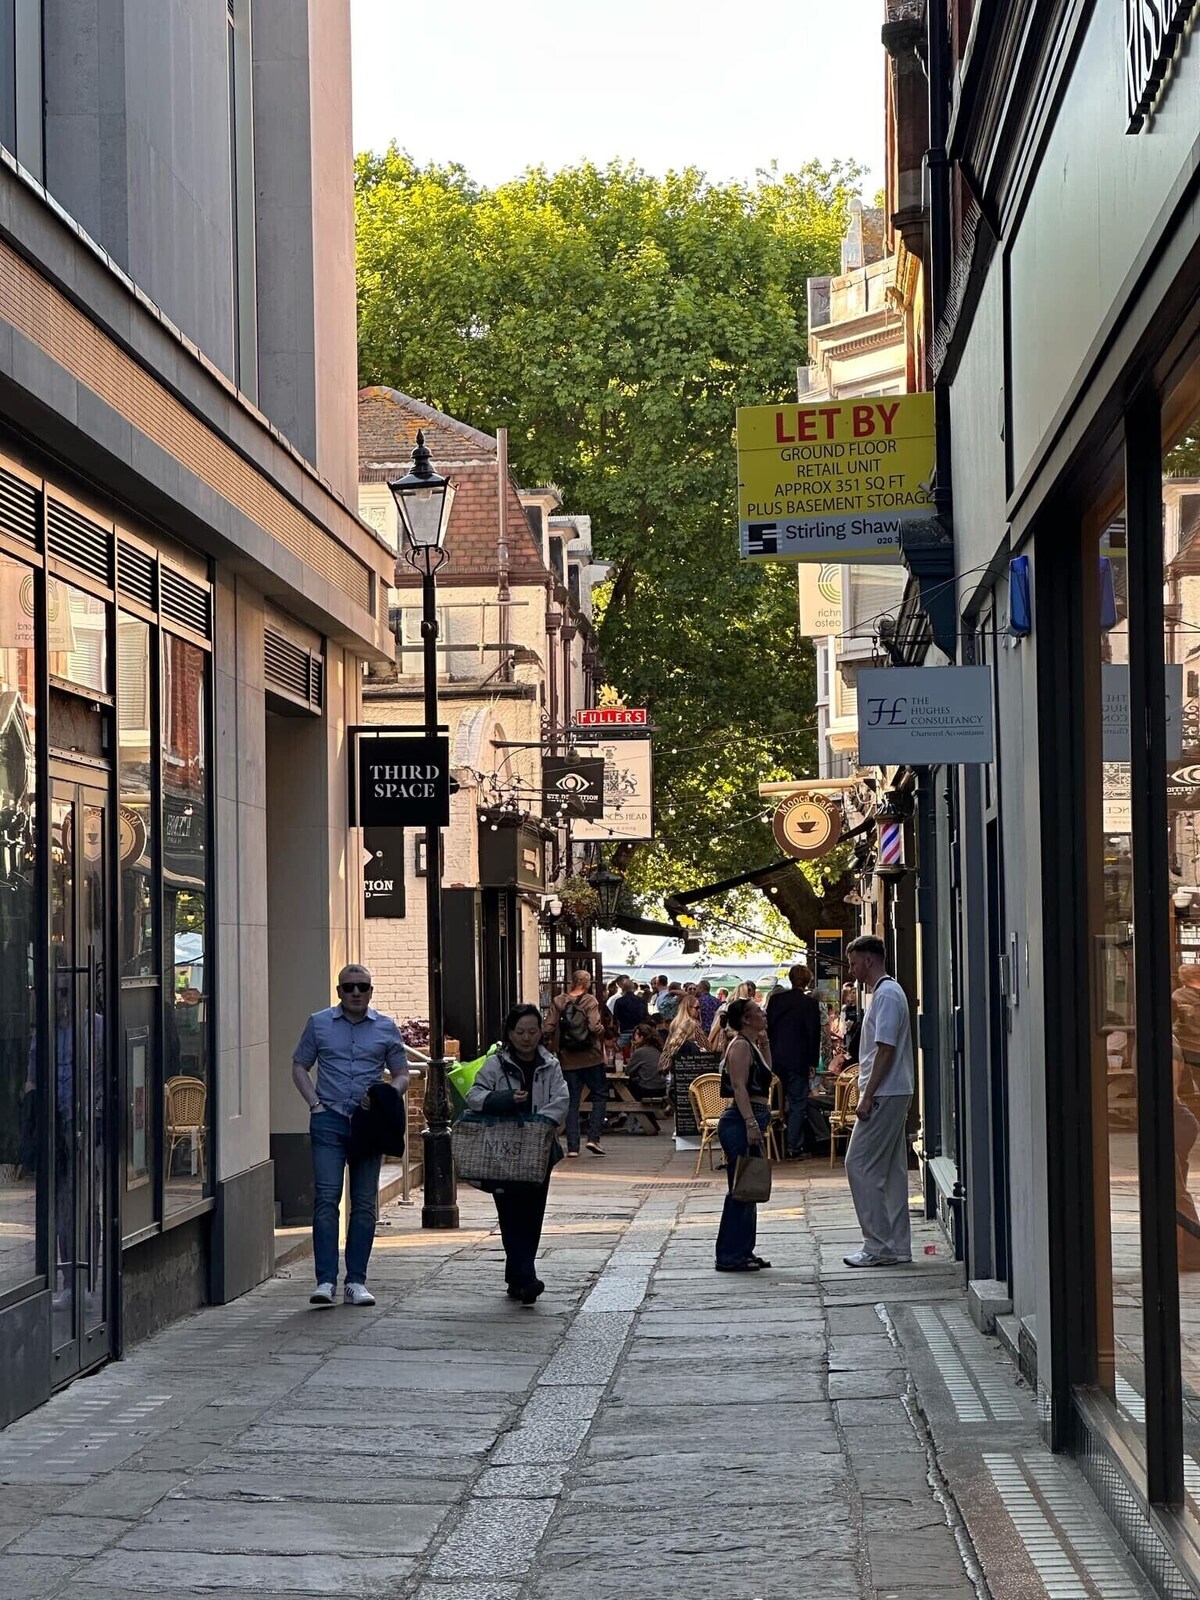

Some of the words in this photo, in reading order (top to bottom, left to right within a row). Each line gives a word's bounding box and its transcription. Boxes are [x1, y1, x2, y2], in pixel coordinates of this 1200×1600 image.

[775, 407, 842, 444] LET
[852, 402, 900, 438] BY
[780, 444, 845, 462] GROUND
[849, 439, 897, 456] FLOOR
[797, 463, 844, 479] RETAIL
[847, 458, 882, 474] UNIT
[774, 480, 832, 497] APPROX
[835, 478, 860, 493] 351
[865, 477, 885, 492] SQ
[889, 474, 906, 488] FT
[747, 501, 783, 517] PLUS
[787, 495, 864, 514] BASEMENT
[785, 521, 846, 541] Stirling
[851, 518, 899, 535] Shaw
[877, 536, 893, 545] 020
[911, 696, 929, 705] THE
[911, 706, 950, 715] HUGHES
[910, 715, 983, 725] CONSULTANCY
[369, 765, 440, 780] THIRD
[374, 783, 436, 798] SPACE
[777, 794, 810, 816] Mooca
[813, 794, 835, 815] Café
[625, 812, 648, 820] HEAD
[484, 1139, 522, 1156] M&S
